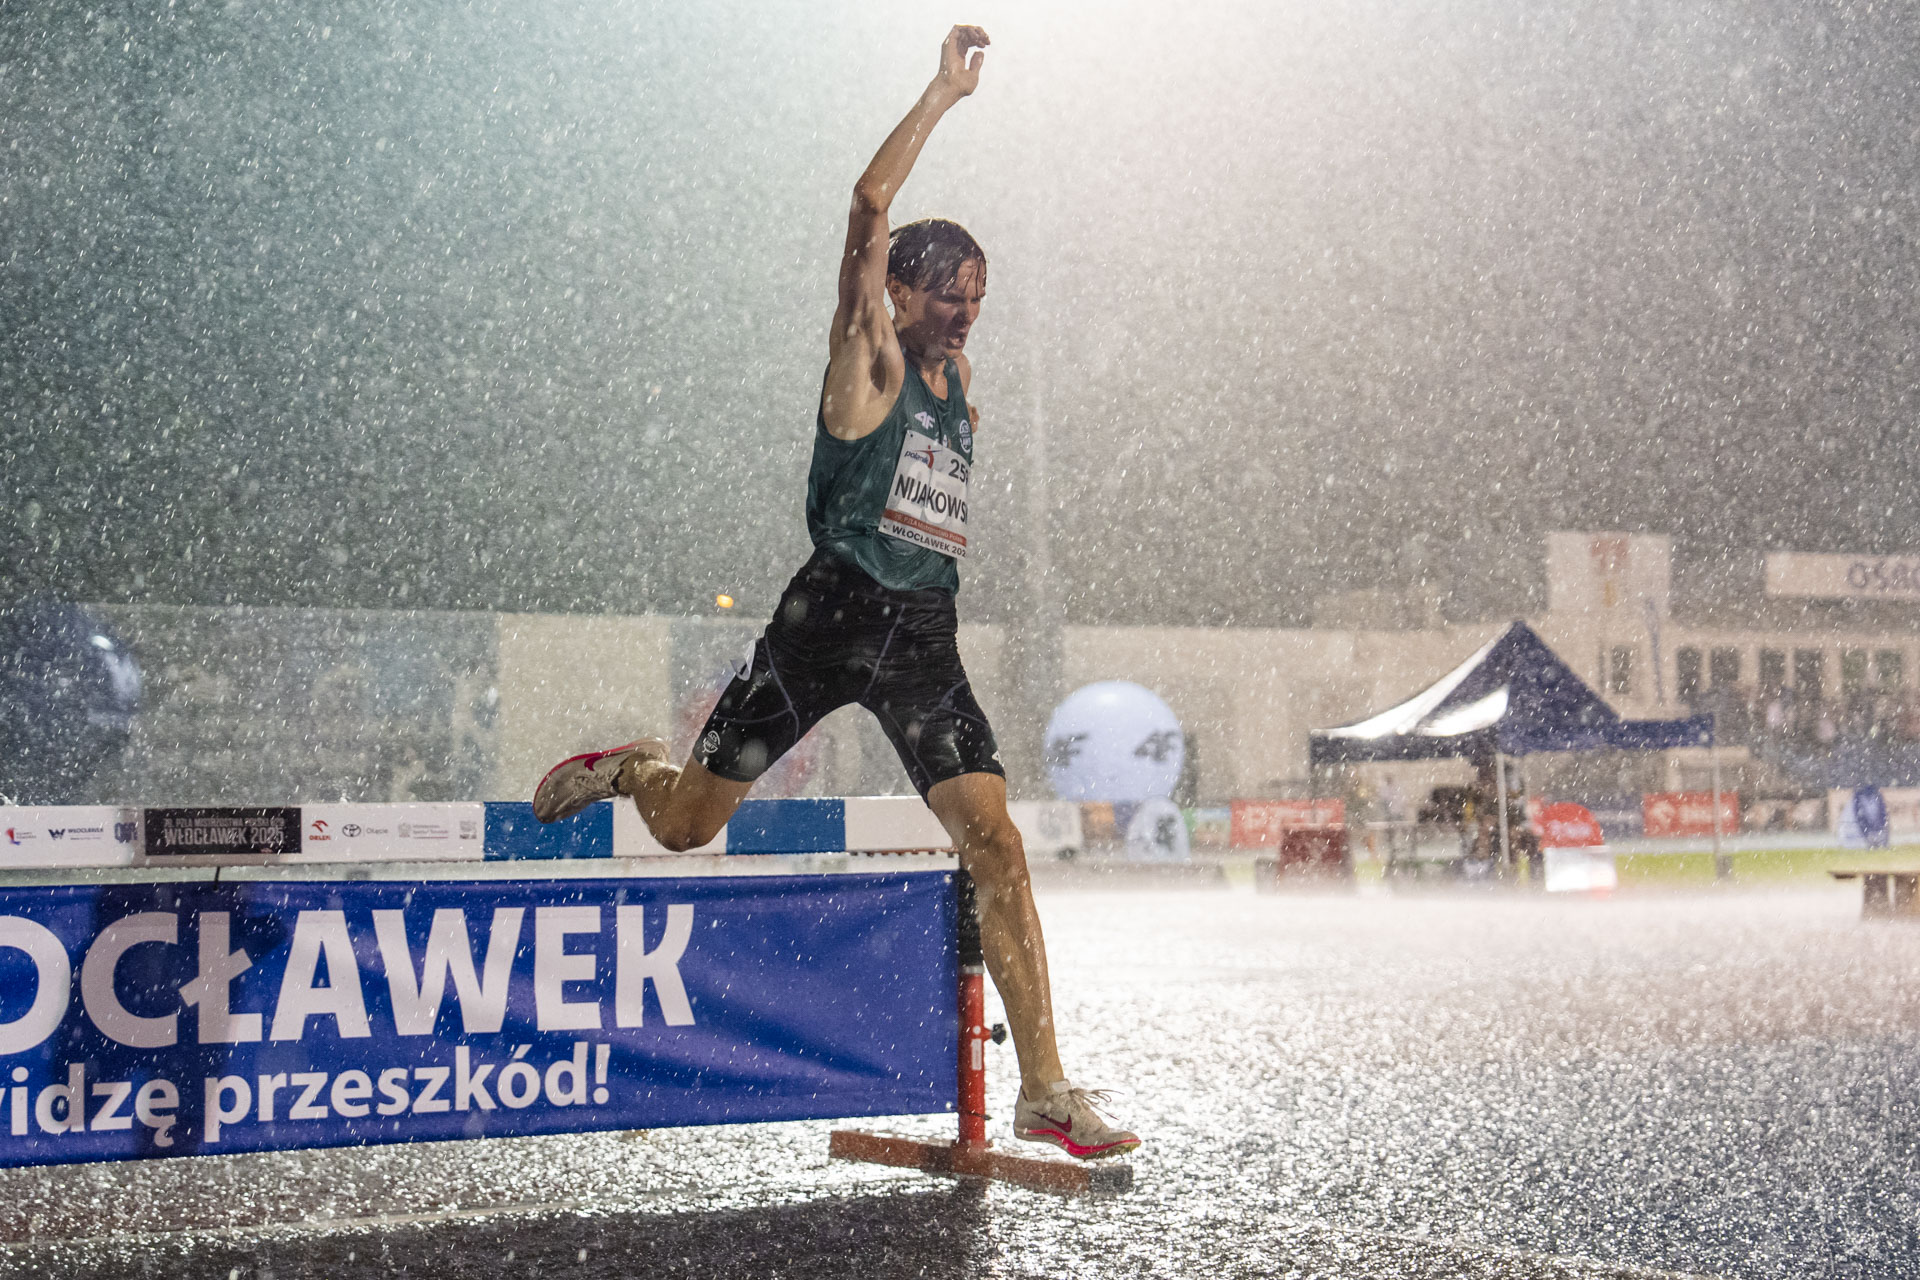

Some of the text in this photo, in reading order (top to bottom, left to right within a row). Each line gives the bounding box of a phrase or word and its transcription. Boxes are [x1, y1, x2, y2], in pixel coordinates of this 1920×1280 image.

[914, 411, 935, 430] 4F
[895, 474, 968, 524] NIJAKOWS
[892, 525, 949, 552] WŁOCŁAWEK
[164, 827, 285, 845] WŁOCŁAWEK 2025
[0, 1041, 611, 1148] idzę przeszkód!
